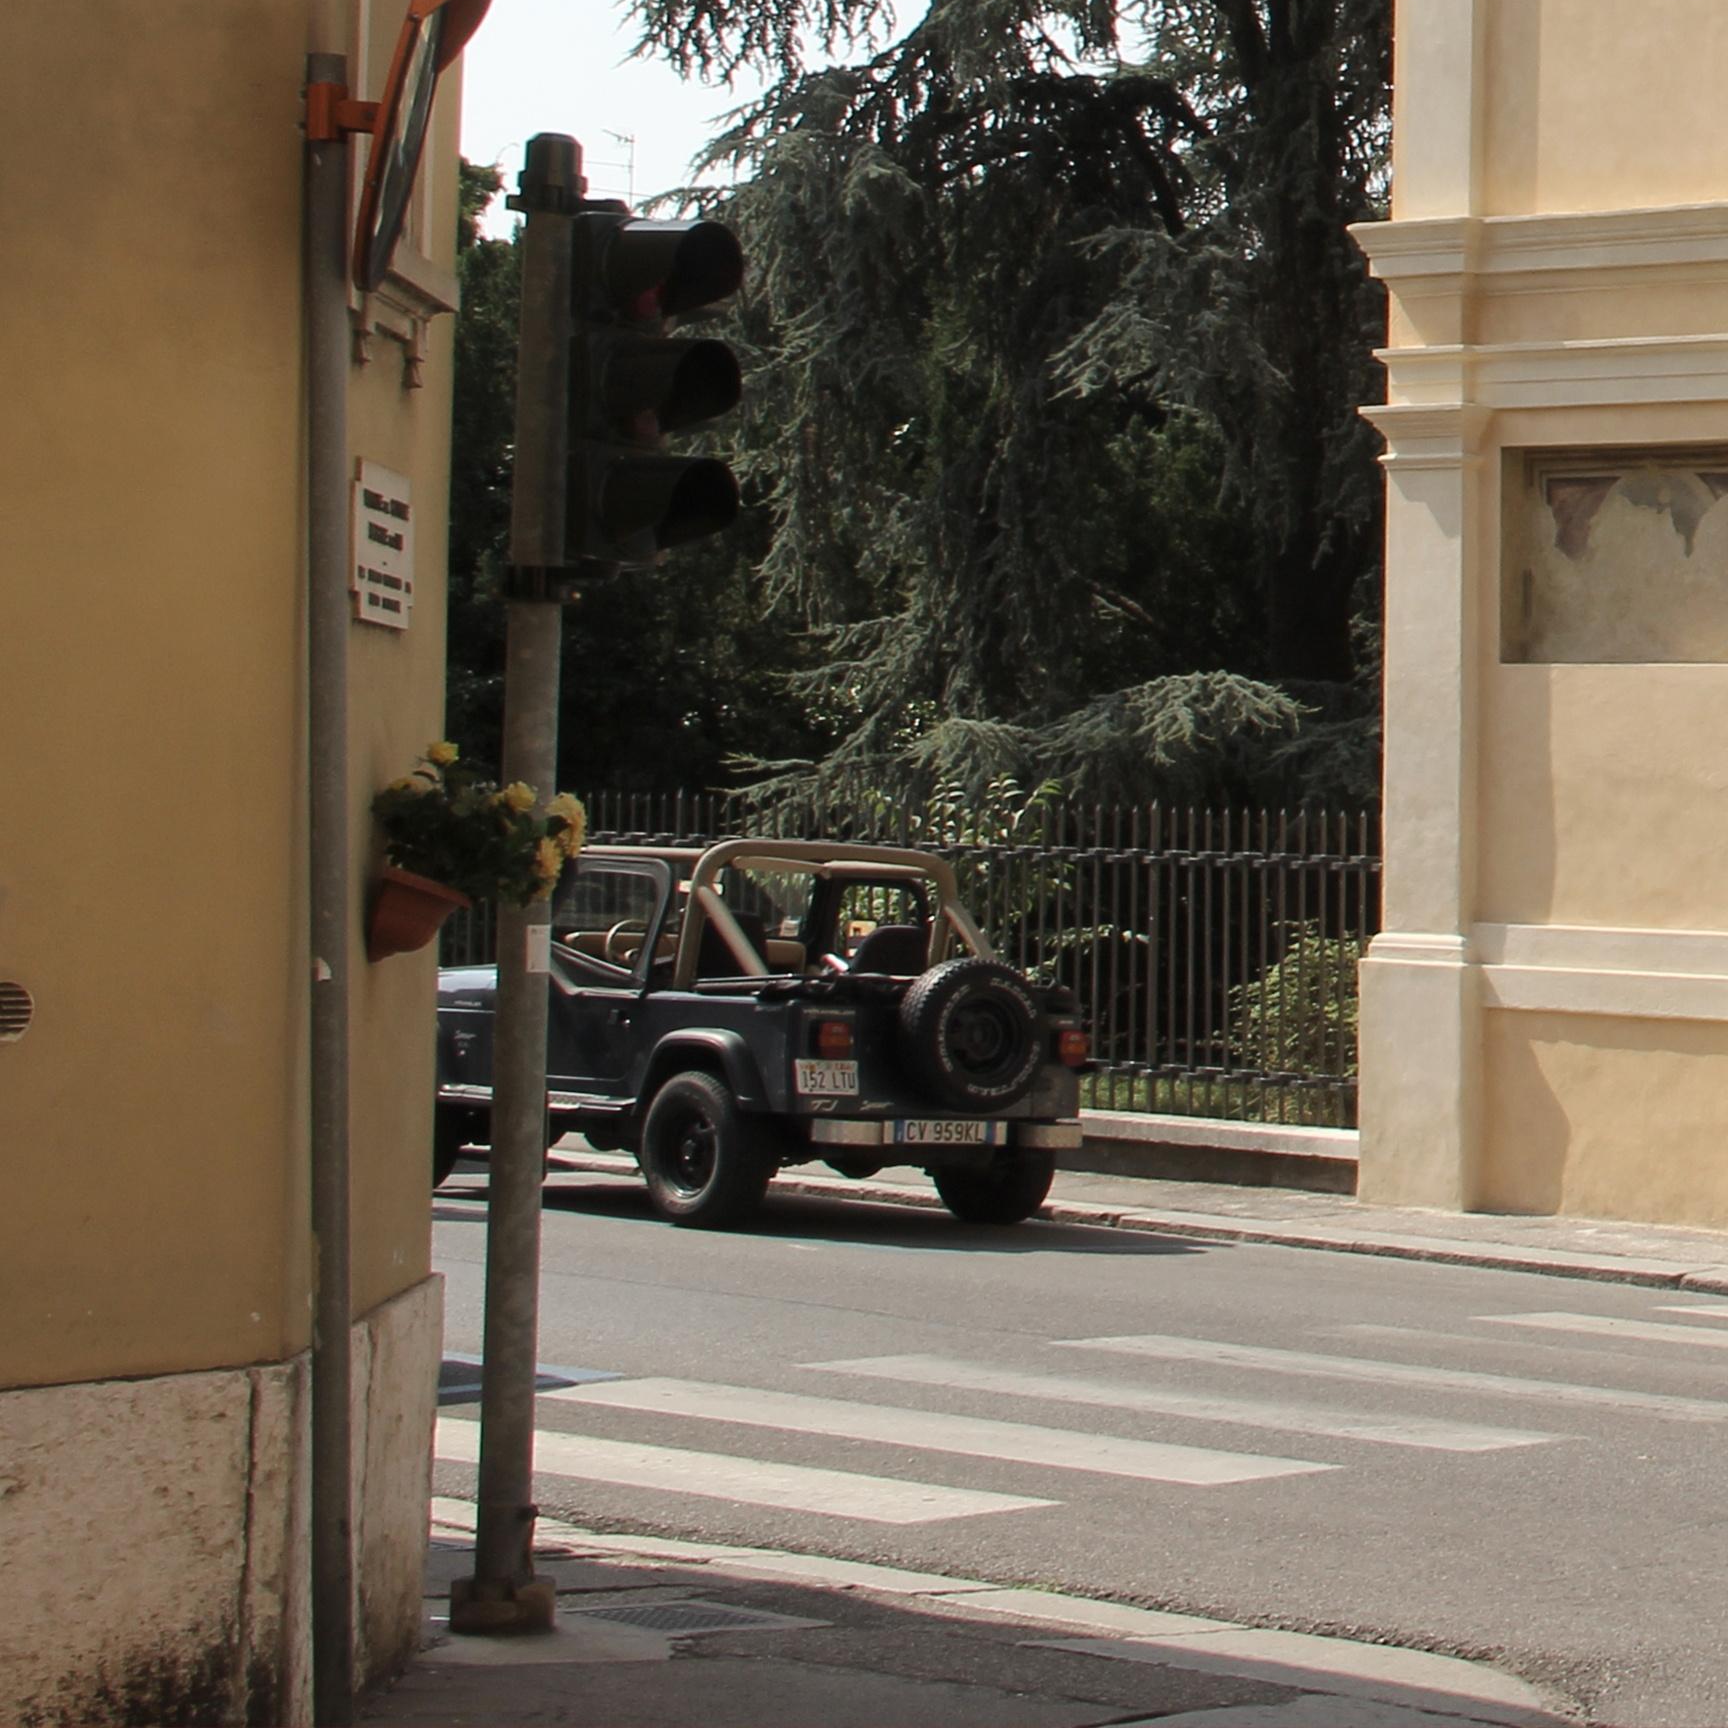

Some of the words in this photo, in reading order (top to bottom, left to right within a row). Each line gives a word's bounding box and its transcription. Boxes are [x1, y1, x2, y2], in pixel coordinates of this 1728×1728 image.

[802, 1071, 826, 1089] 152
[831, 1071, 856, 1089] LTU
[906, 1121, 926, 1142] CV
[933, 1121, 983, 1142] 959KL
